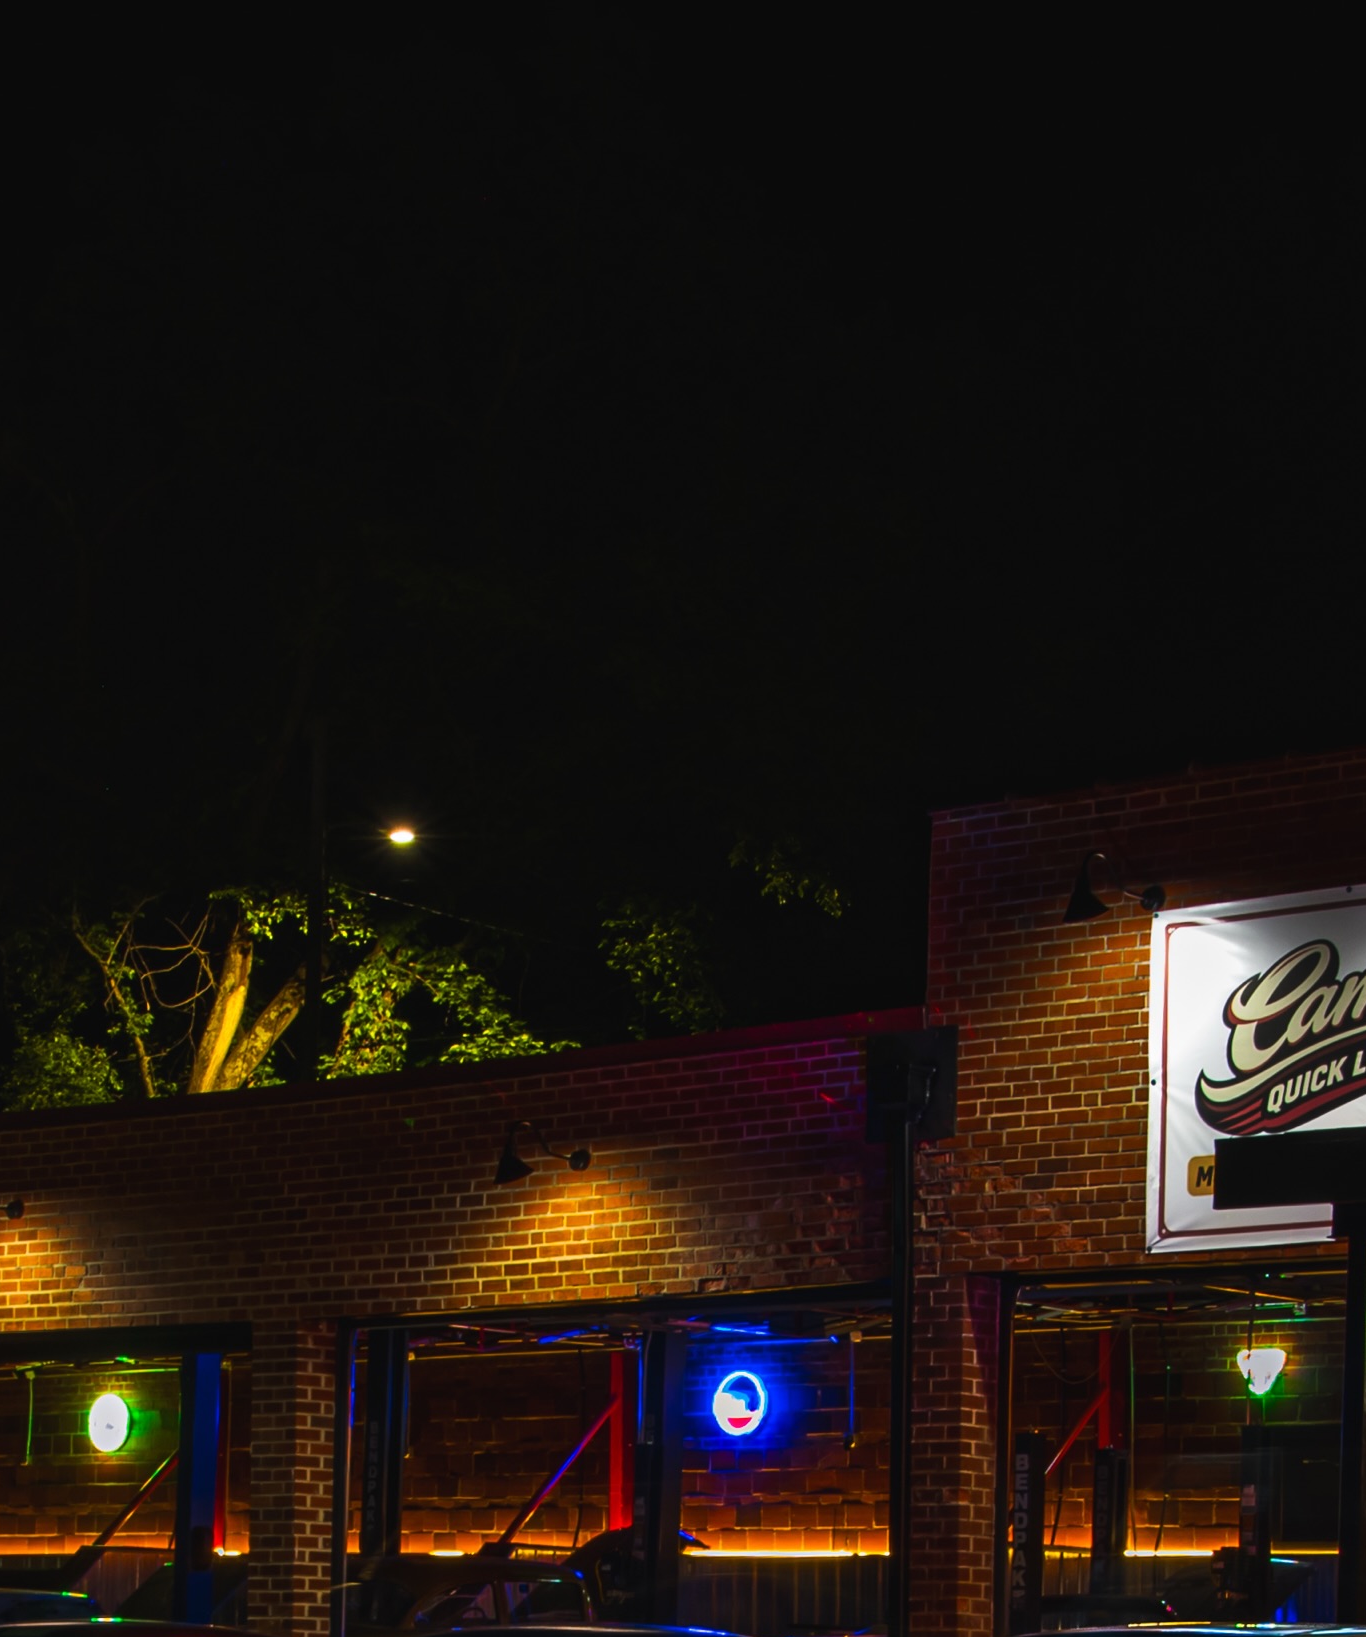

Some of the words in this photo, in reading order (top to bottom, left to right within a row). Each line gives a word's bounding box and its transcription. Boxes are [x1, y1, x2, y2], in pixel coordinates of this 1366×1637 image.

[1267, 1055, 1348, 1113] QUICK
[1195, 1165, 1214, 1187] M
[1012, 1454, 1029, 1587] BENDPAK
